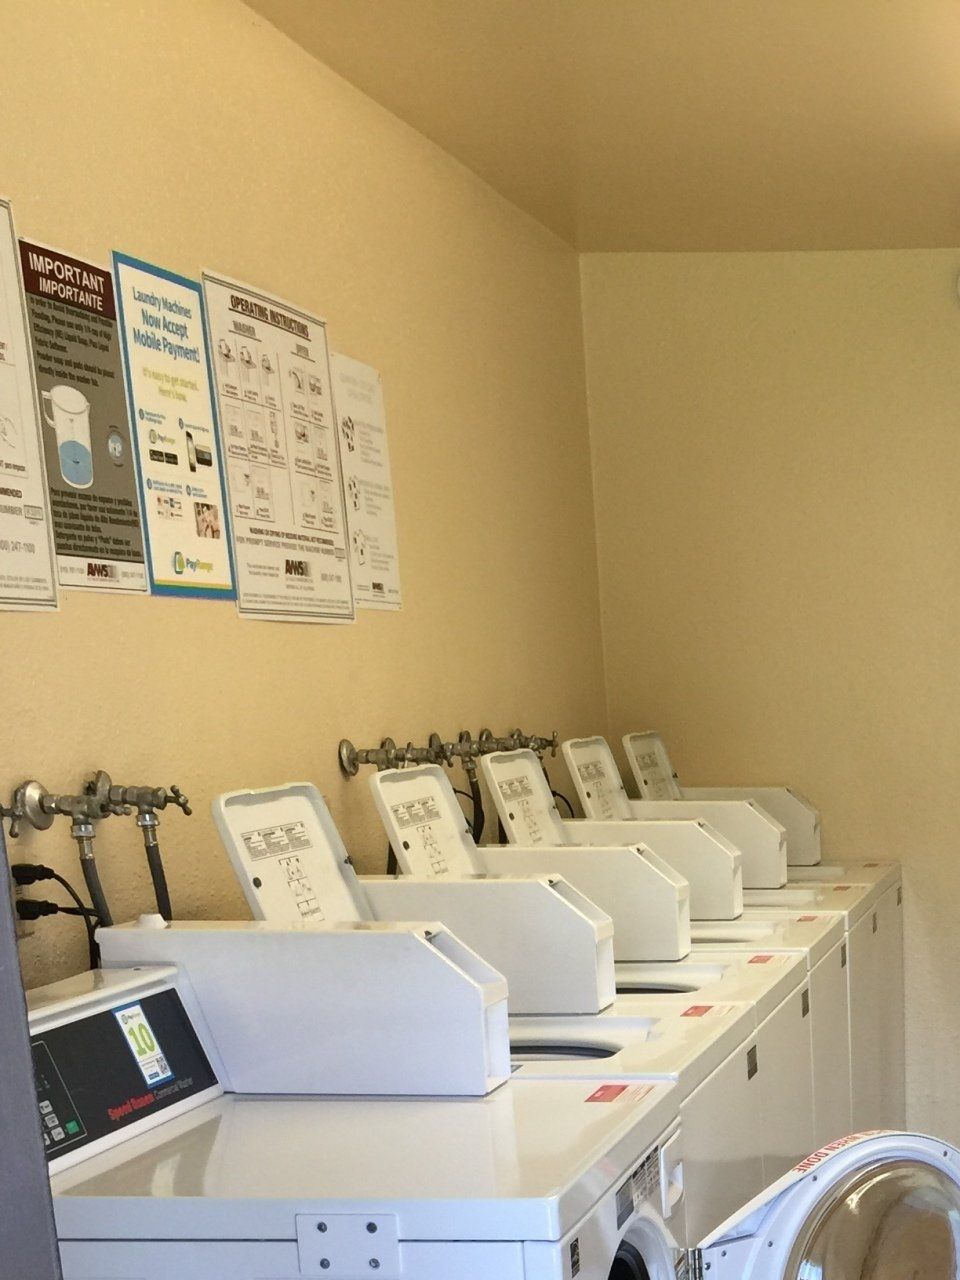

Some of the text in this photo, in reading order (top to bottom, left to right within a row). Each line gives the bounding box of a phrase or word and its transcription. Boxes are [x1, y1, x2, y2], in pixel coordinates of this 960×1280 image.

[29, 252, 104, 294] IMPORTANT
[39, 277, 103, 311] IMPORTANTE
[133, 286, 192, 319] Laundry Machines
[141, 309, 188, 340] Now Accept
[230, 294, 309, 337] OPERATING INSTRUCTIONS
[133, 326, 200, 363] Mobile Payment!
[128, 1022, 155, 1057] 10
[792, 1135, 859, 1173] WHEN DONE
